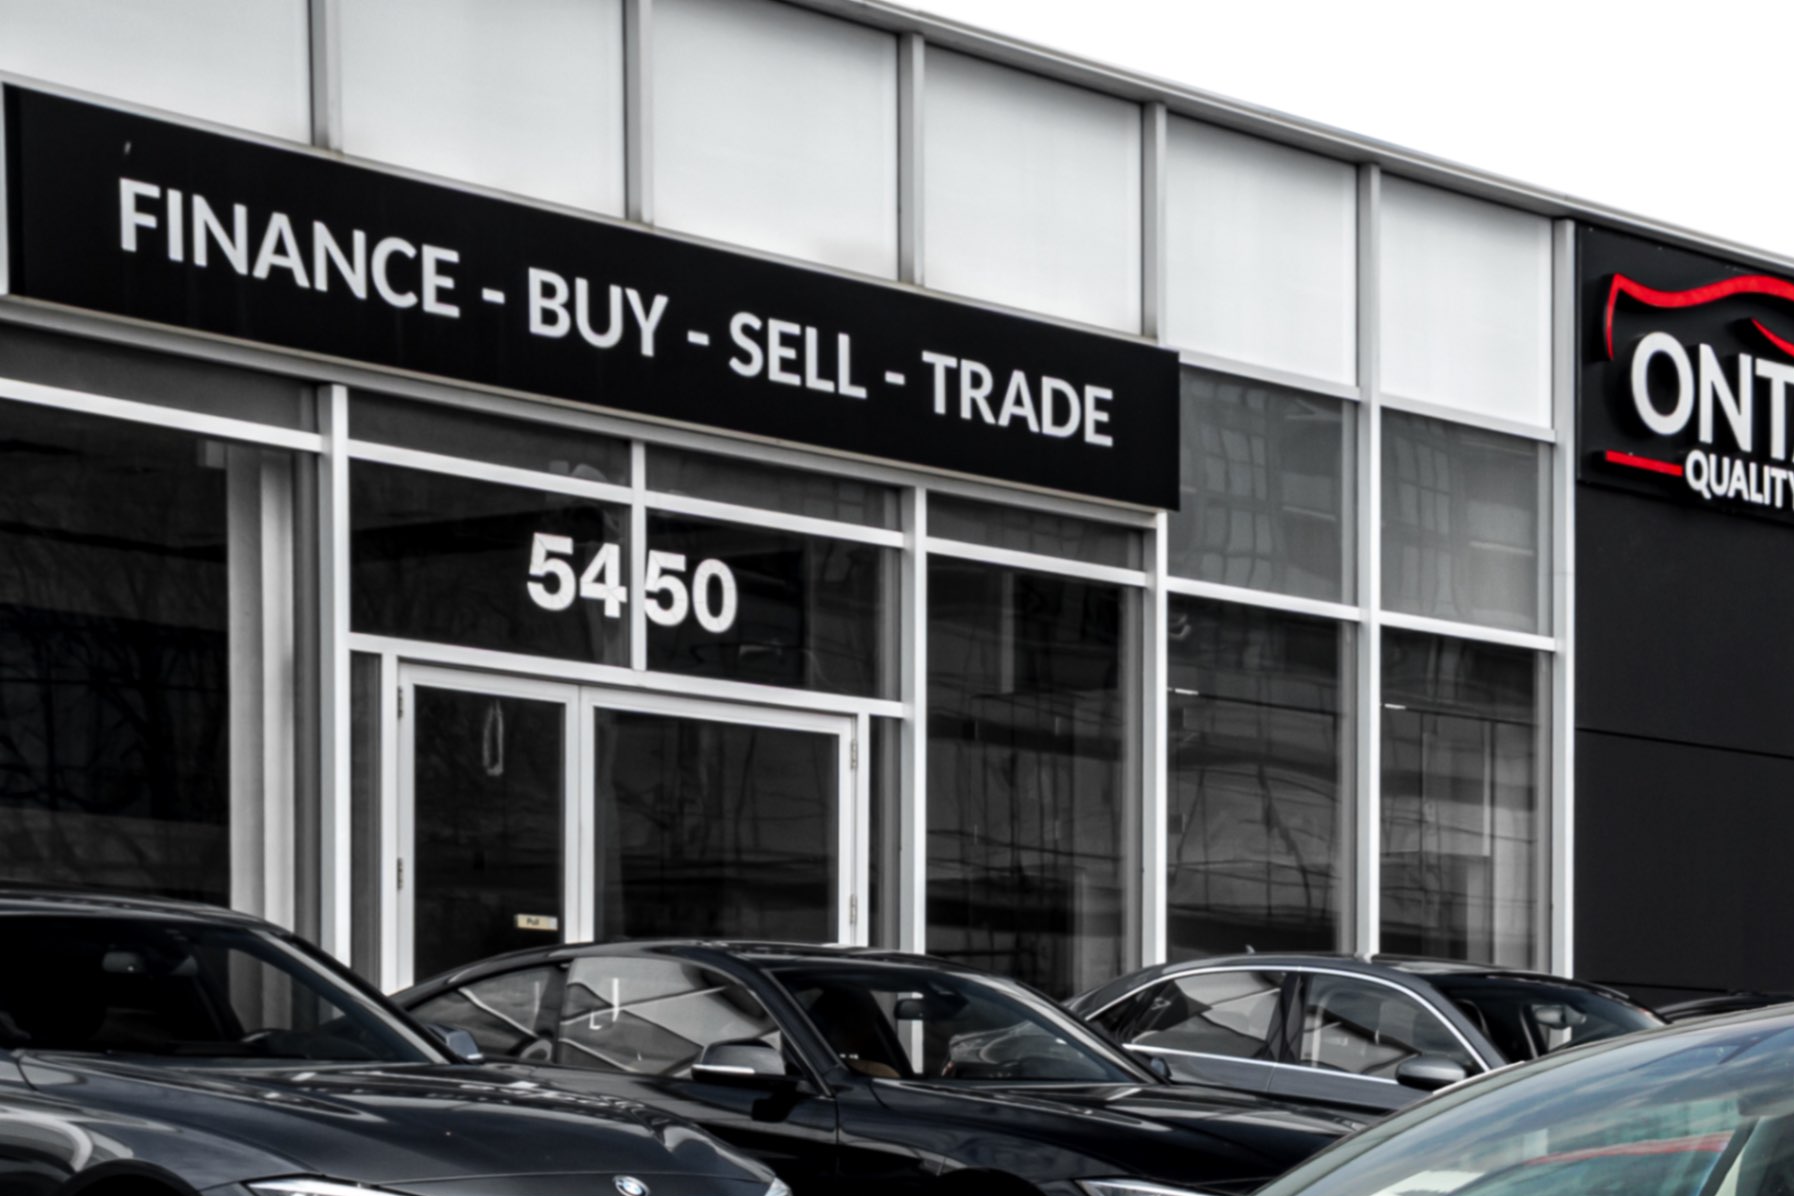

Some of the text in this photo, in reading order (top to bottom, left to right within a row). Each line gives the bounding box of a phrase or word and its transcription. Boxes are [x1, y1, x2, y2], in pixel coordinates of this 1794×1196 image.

[119, 178, 461, 318] FINANCE
[528, 267, 669, 357] BUY
[729, 312, 867, 399] SELL
[921, 350, 1114, 447] TRADE
[527, 532, 738, 633] 5450
